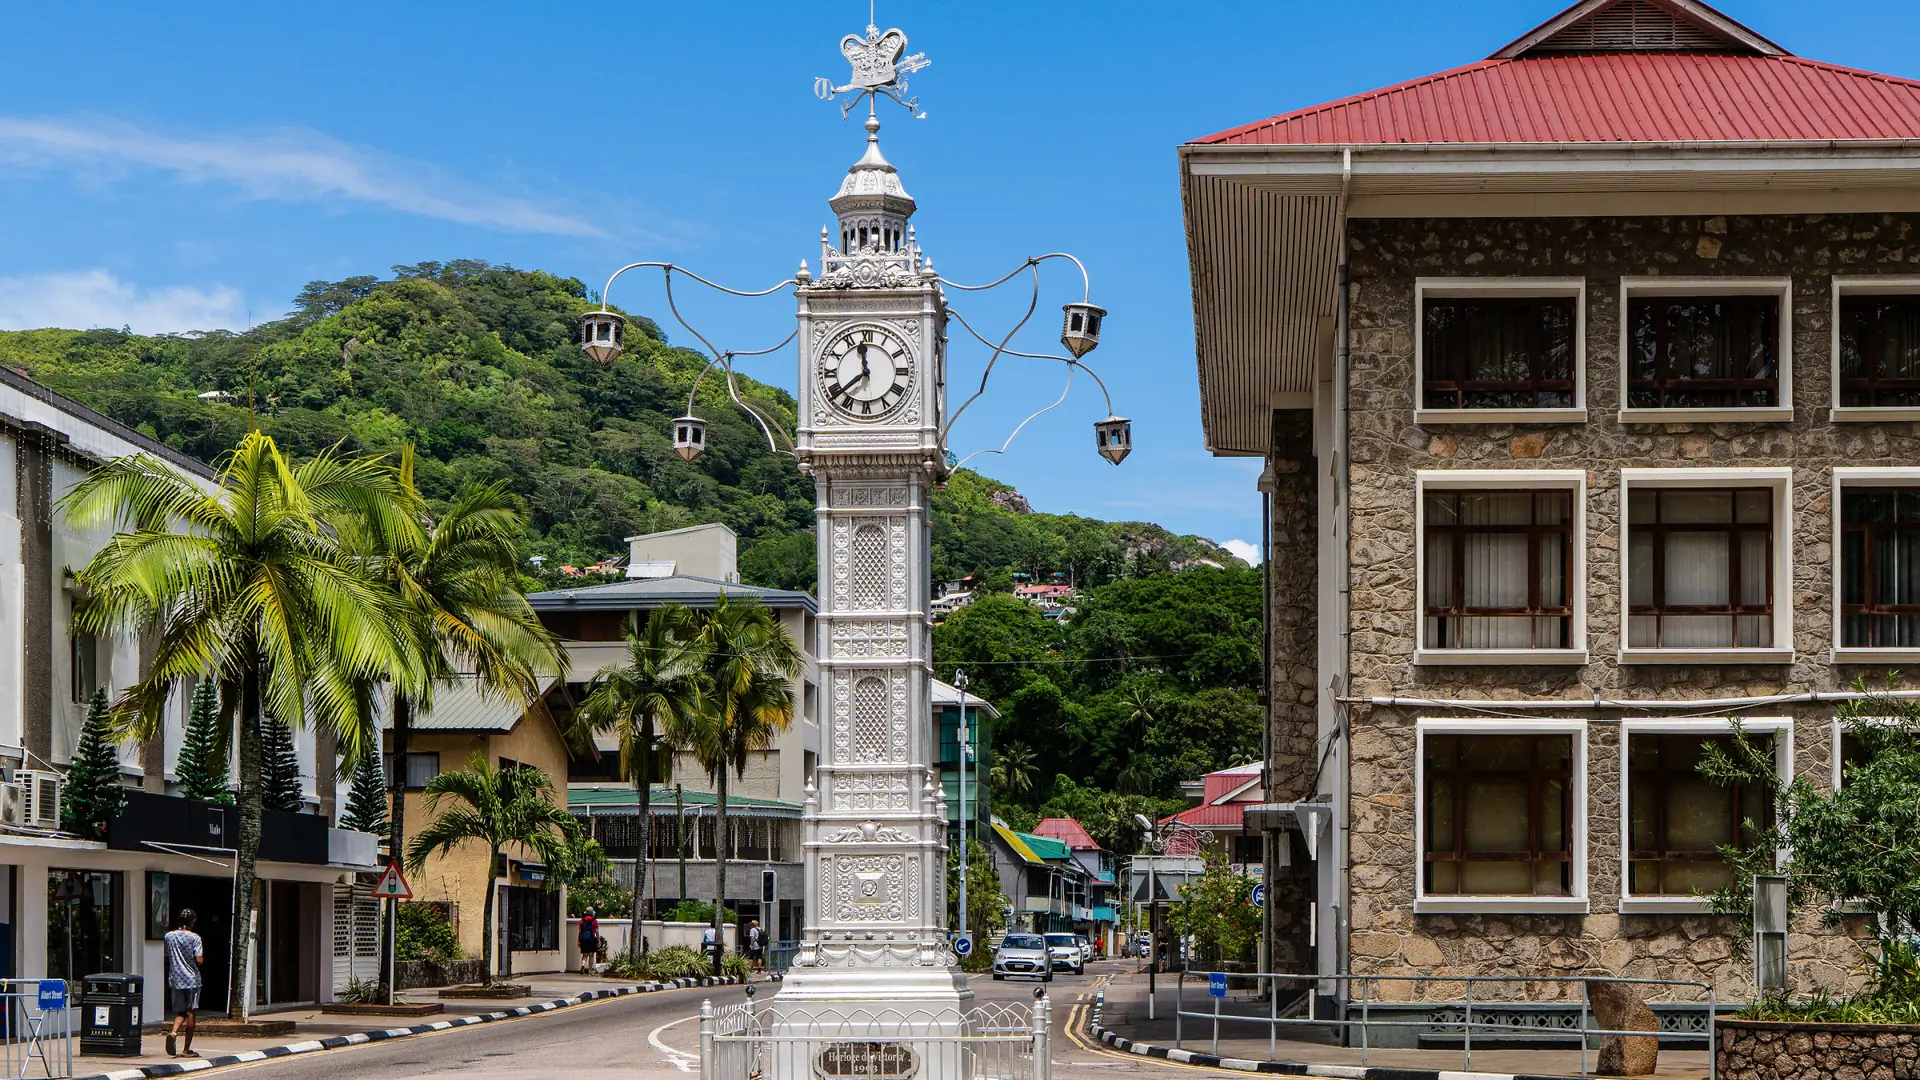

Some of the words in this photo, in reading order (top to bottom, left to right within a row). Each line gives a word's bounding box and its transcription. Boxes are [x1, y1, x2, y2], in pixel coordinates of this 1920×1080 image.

[843, 334, 856, 349] XI
[861, 330, 873, 343] XII
[881, 336, 888, 346] I
[830, 350, 842, 361] X
[892, 349, 905, 359] II
[880, 397, 891, 410] V
[861, 1051, 870, 1062] d
[870, 1051, 905, 1062] Vitora
